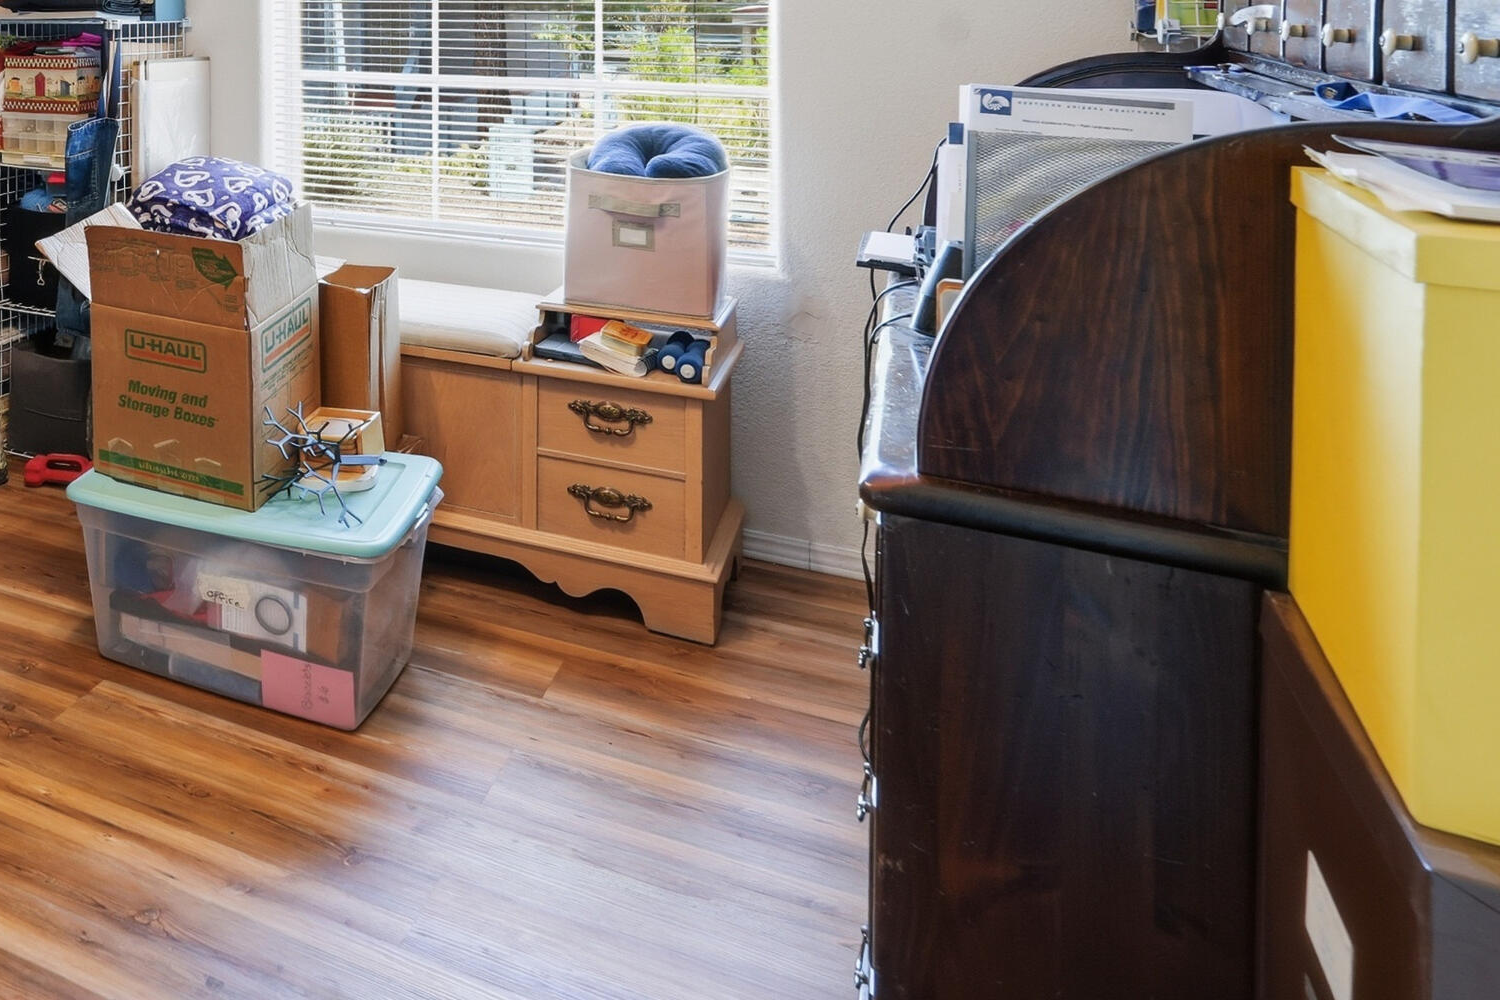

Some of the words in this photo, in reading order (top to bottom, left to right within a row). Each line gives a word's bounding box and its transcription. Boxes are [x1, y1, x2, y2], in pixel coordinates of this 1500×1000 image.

[264, 306, 309, 354] U-HAUL
[129, 334, 202, 361] U-HAUL
[127, 379, 178, 405] Moving
[181, 393, 209, 409] and
[118, 394, 170, 418] Storage
[174, 406, 217, 428] Boxes
